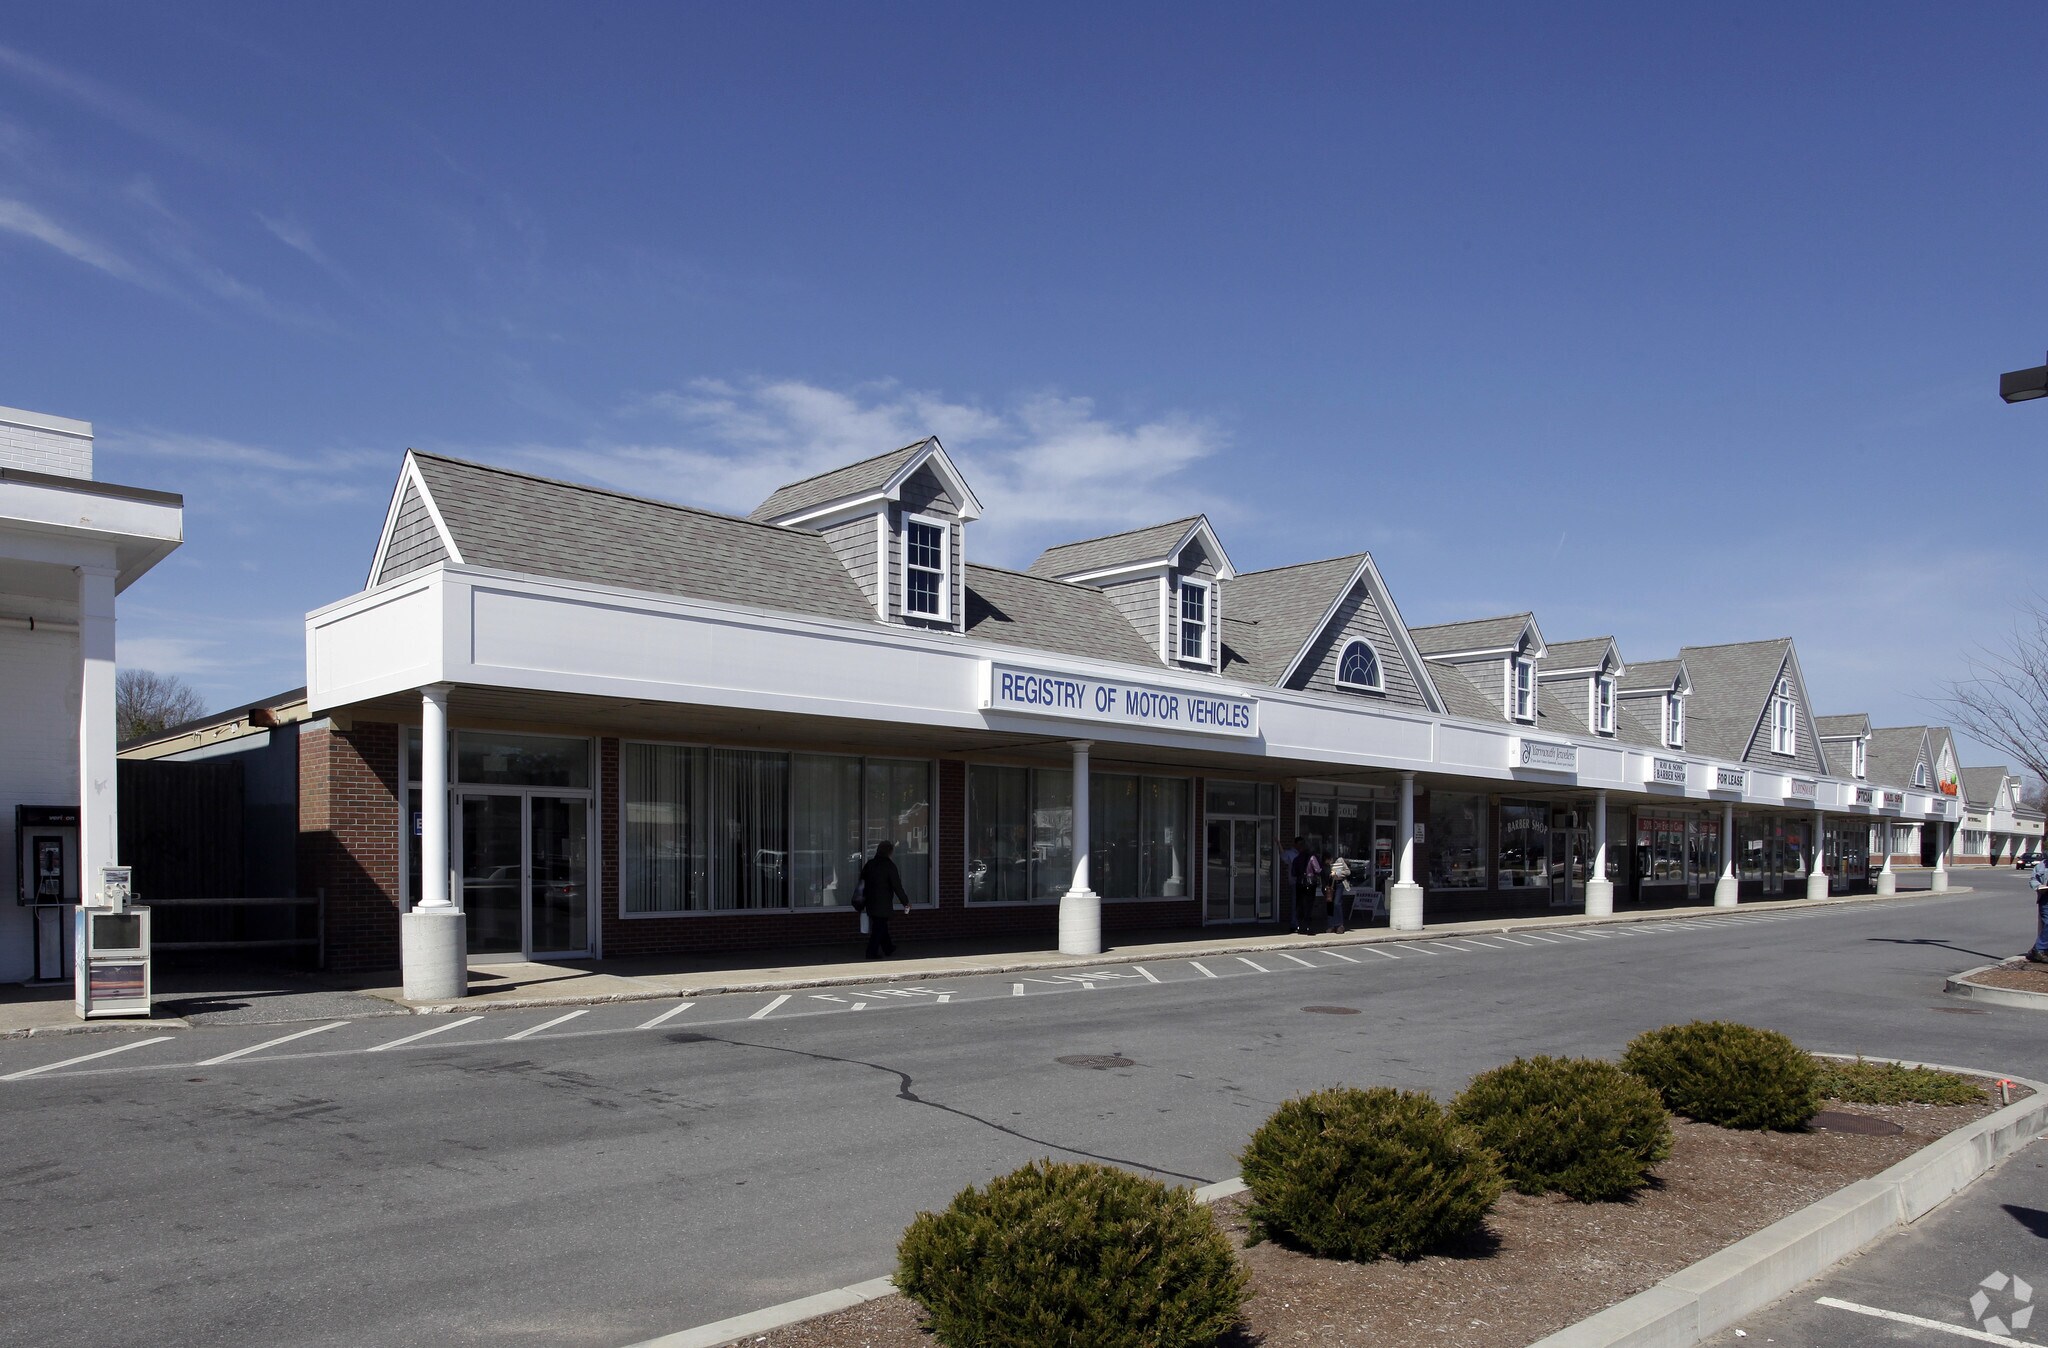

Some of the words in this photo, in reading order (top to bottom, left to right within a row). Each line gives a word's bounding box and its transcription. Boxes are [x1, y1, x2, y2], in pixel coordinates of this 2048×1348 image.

[1001, 673, 1085, 709] REGISTRY
[1095, 686, 1117, 713] OF
[1126, 690, 1179, 720] MOTOR
[1187, 698, 1250, 729] VEHICLES
[1532, 744, 1556, 758] Yarmouth
[1555, 748, 1575, 761] Jewelers
[1672, 763, 1683, 771] SONS
[1656, 769, 1674, 780] BARBER
[1674, 771, 1686, 782] SHOP
[1717, 773, 1728, 785] FOR
[1728, 774, 1743, 787] LEASE
[1507, 818, 1530, 833] BARBER
[1531, 819, 1549, 835] SHOP
